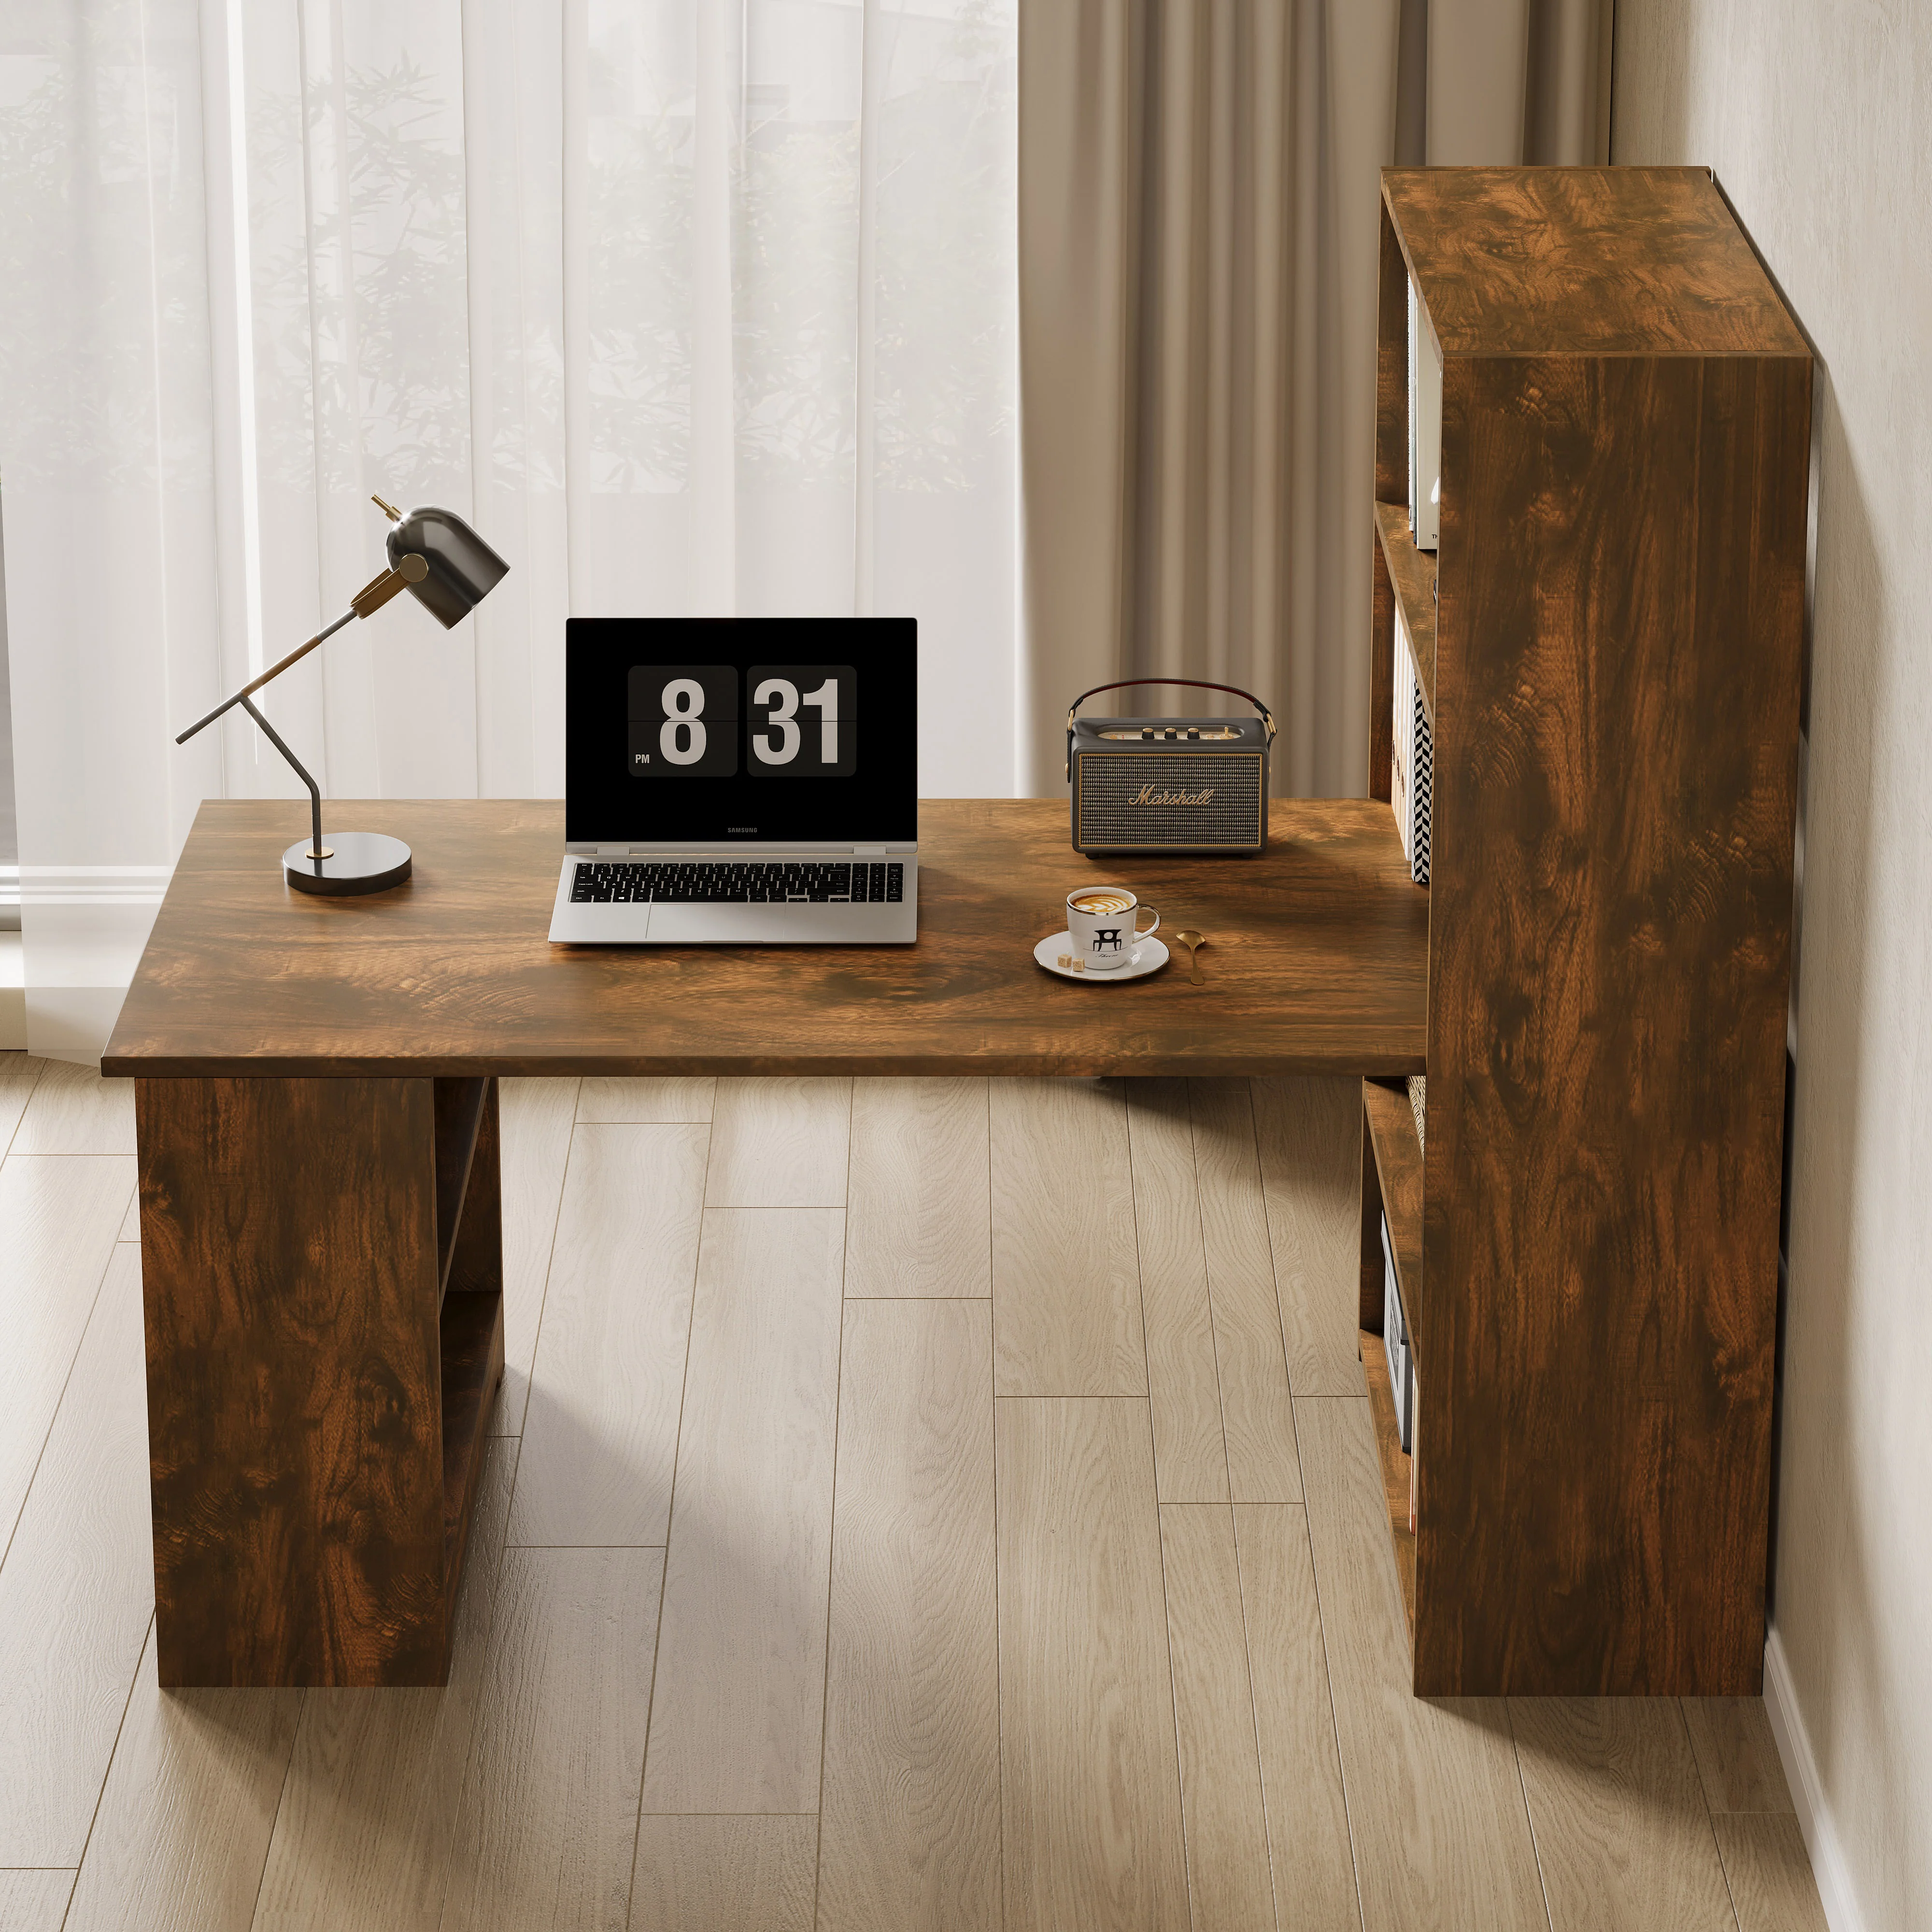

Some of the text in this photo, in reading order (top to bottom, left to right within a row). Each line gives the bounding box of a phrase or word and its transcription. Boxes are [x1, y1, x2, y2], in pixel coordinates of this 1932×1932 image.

[660, 679, 838, 765] 8 31
[635, 754, 650, 764] PM
[1128, 784, 1214, 805] Marshall
